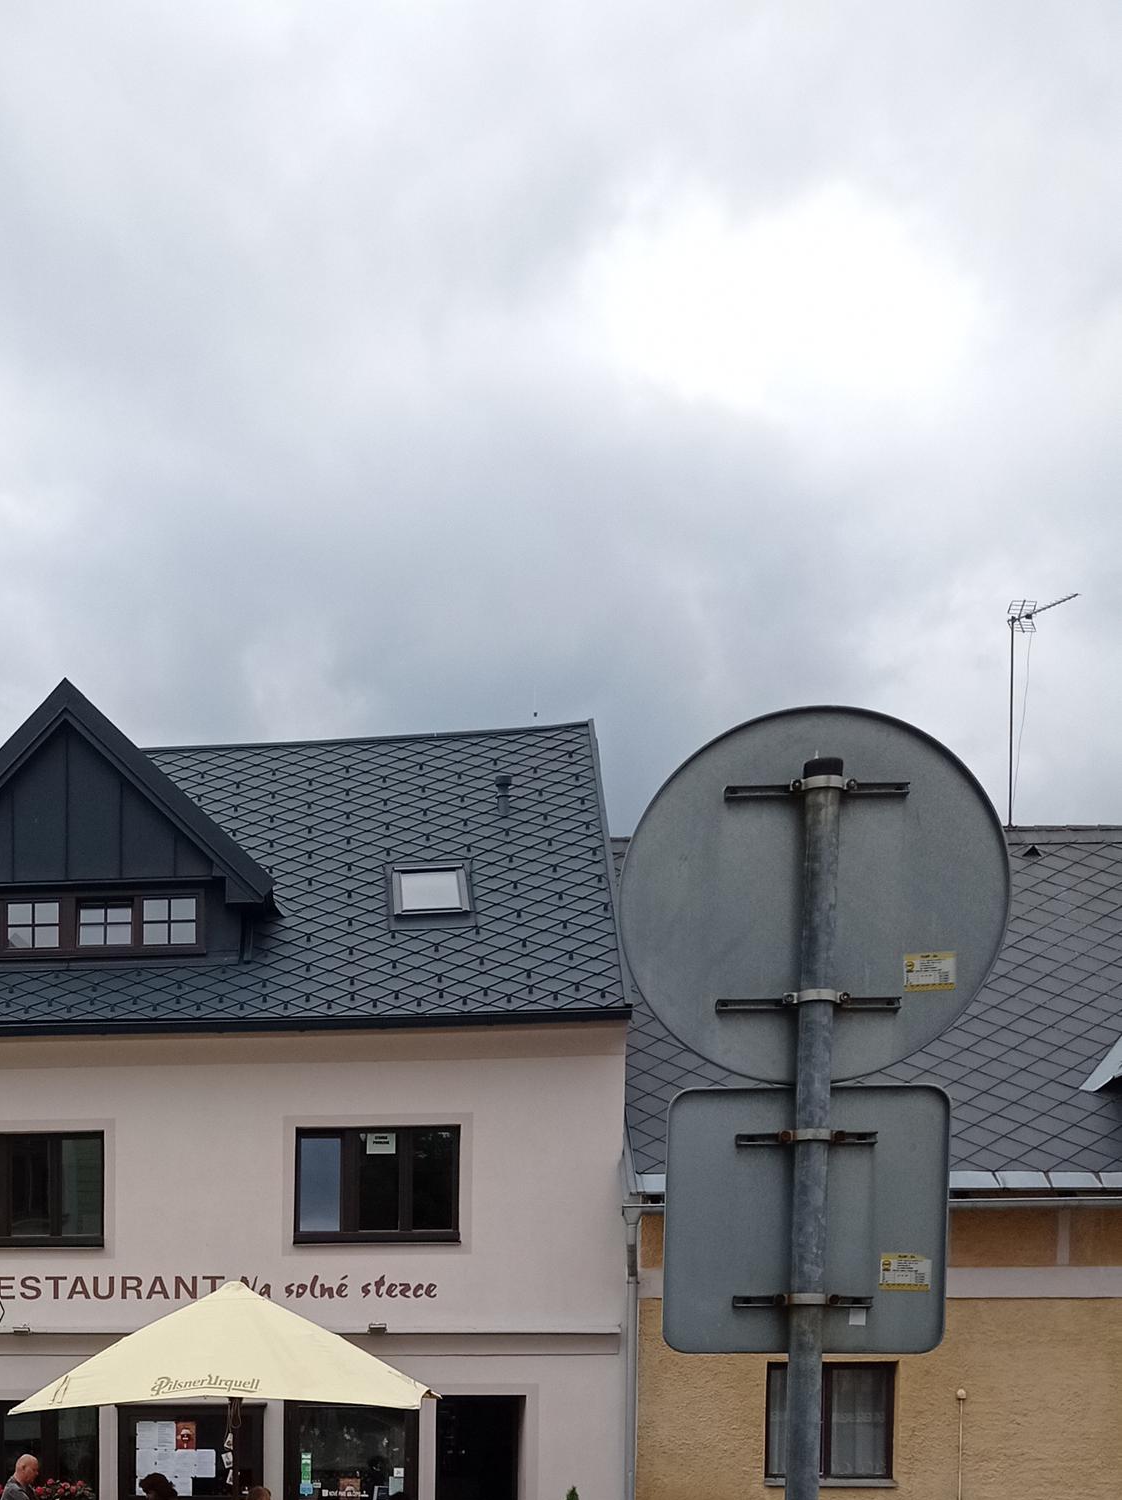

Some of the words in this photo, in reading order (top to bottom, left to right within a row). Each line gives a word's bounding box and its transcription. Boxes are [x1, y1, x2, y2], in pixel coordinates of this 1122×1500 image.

[285, 1274, 349, 1299] solné
[361, 1274, 438, 1300] stezce
[150, 1376, 208, 1396] Pilsner
[207, 1374, 260, 1392] Urquell
